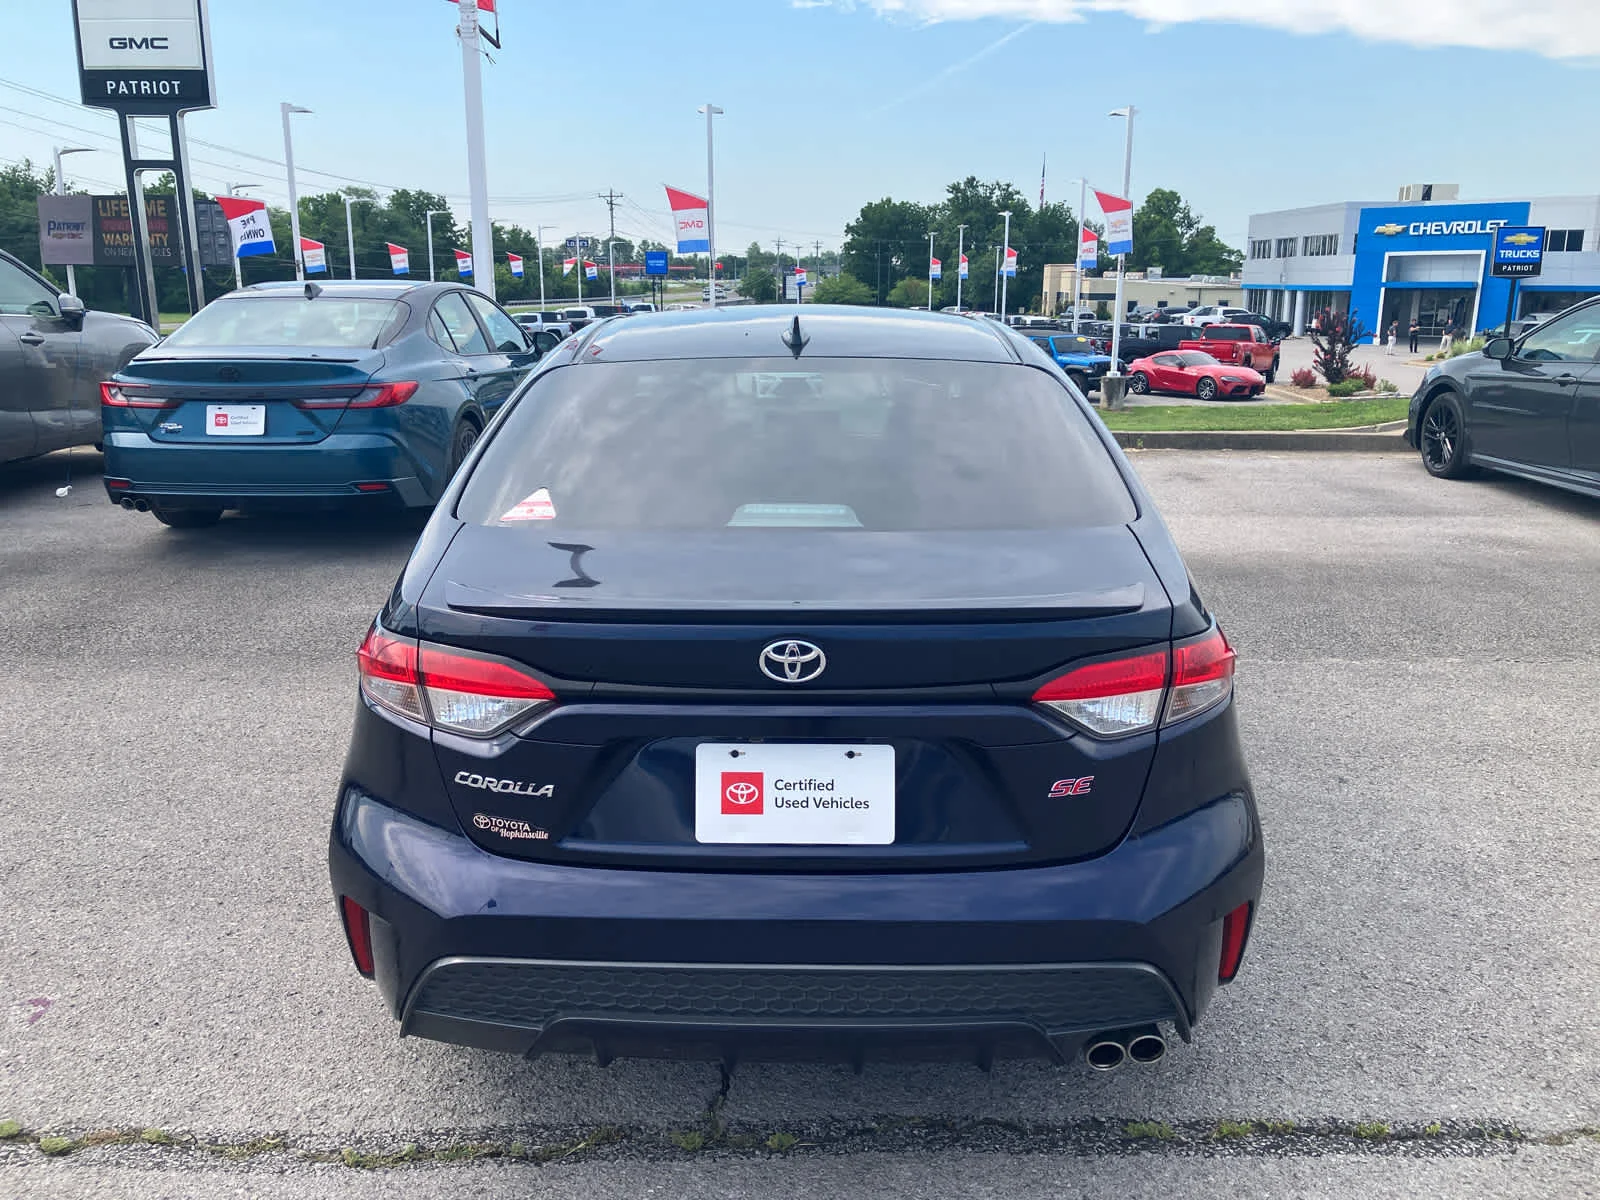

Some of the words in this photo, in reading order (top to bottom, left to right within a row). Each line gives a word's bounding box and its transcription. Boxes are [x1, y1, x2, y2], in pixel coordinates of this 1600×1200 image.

[109, 37, 169, 50] GMC
[106, 80, 181, 95] PATRIOT
[98, 199, 167, 217] LIFEME
[1408, 219, 1508, 236] CHEVROLET
[102, 232, 169, 247] WARNTY
[1499, 249, 1541, 259] TRUCKS
[454, 771, 554, 798] COROLLA
[774, 778, 835, 792] Certified
[1048, 775, 1095, 798] SE
[774, 796, 810, 809] Used
[813, 795, 870, 809] Vehicles
[490, 817, 531, 831] TOYOTA
[500, 828, 549, 840] Hopkinsville
